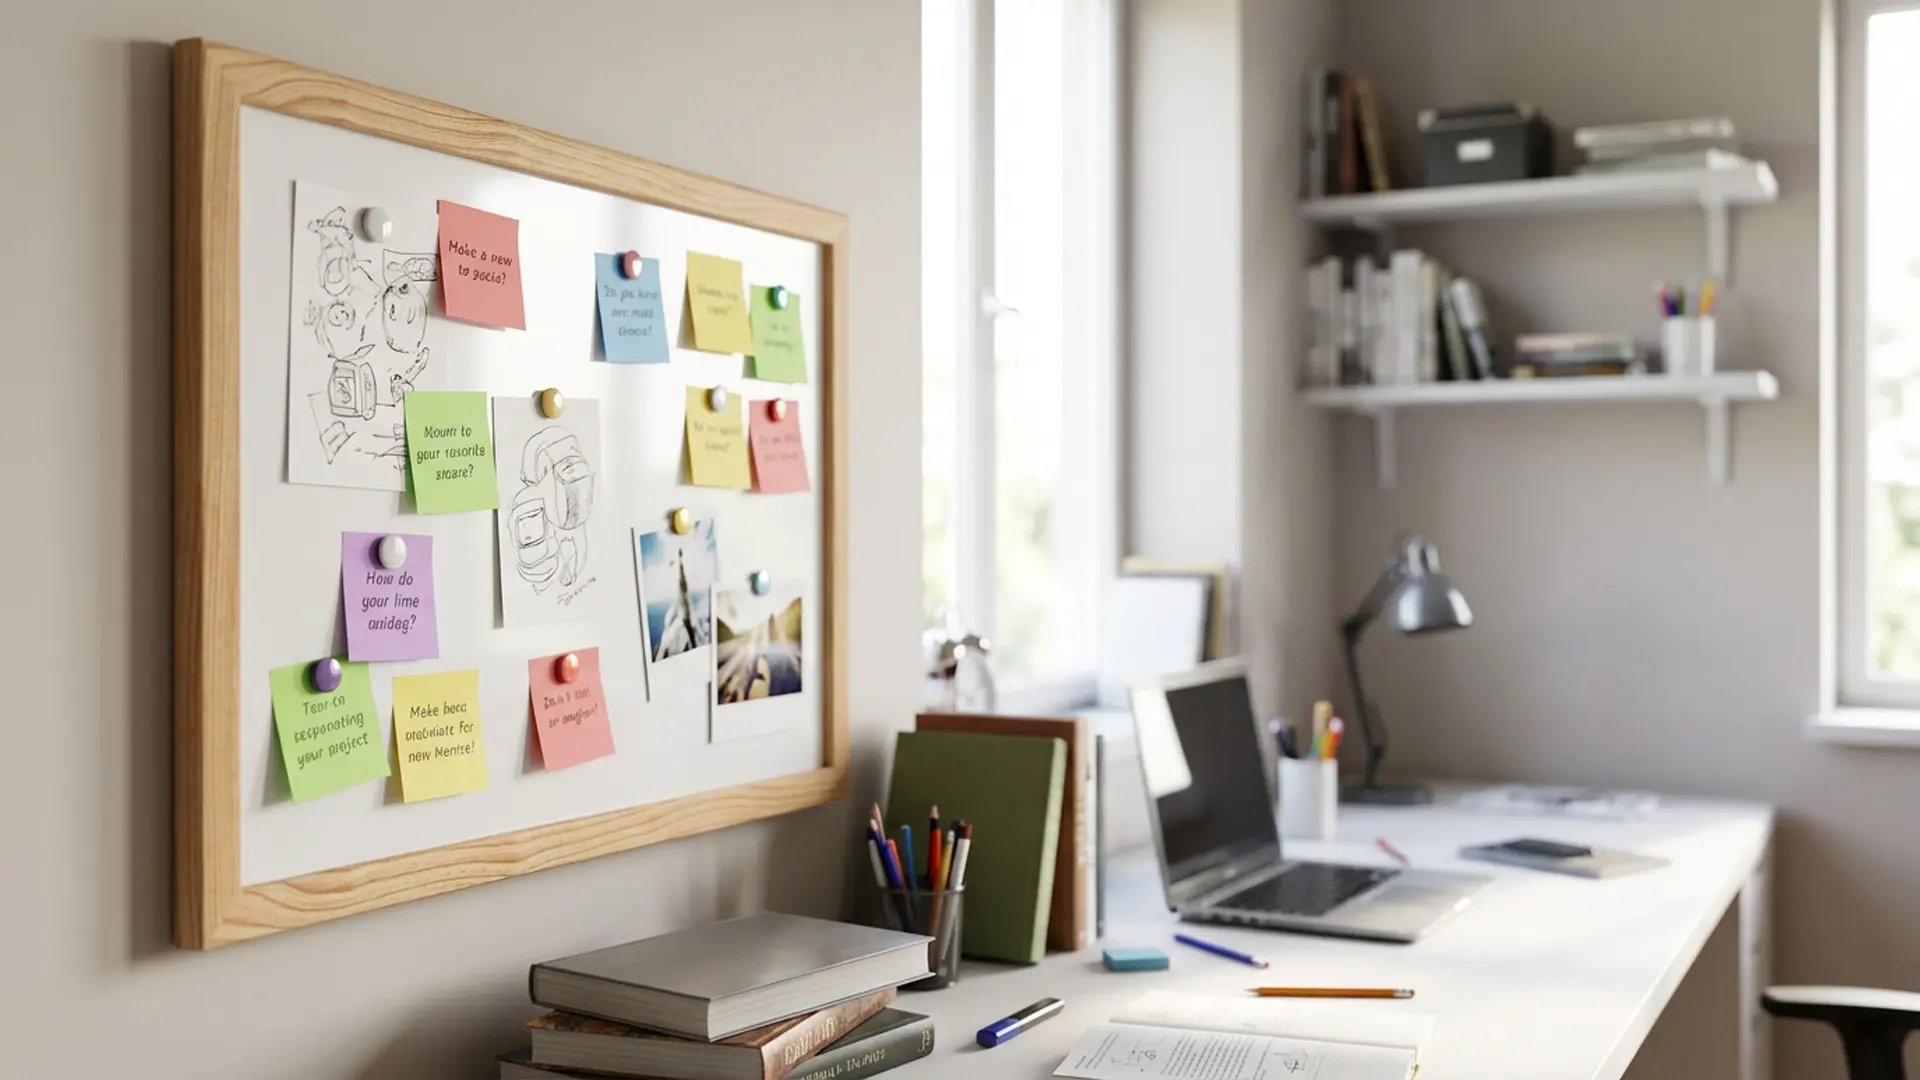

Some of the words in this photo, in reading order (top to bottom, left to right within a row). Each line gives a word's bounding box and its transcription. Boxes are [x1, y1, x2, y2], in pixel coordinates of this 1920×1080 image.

[460, 425, 472, 437] to
[398, 571, 414, 586] do
[362, 596, 389, 612] your
[408, 751, 431, 763] new
